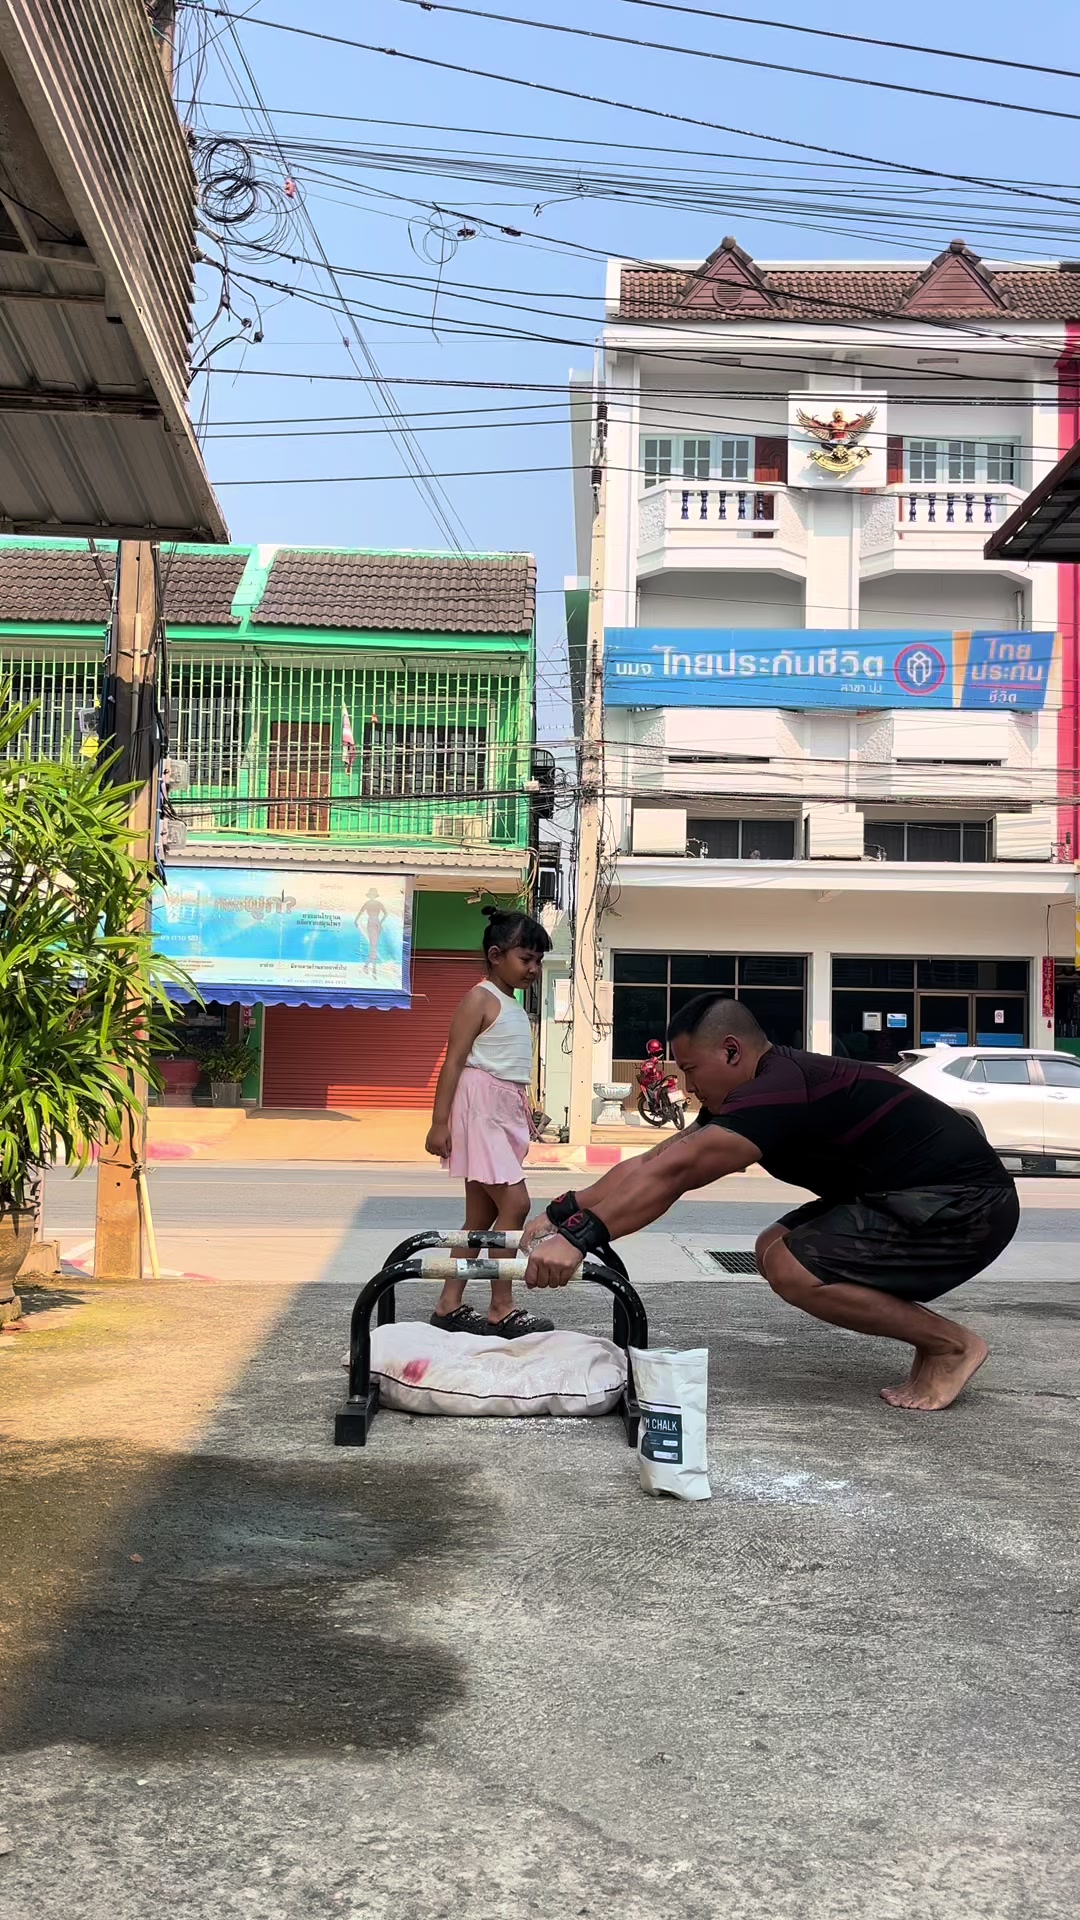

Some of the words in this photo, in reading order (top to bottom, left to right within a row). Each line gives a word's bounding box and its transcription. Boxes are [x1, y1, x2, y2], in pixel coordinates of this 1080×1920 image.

[984, 638, 1032, 660] ไทย
[652, 645, 883, 678] ไทยประกันชีวิต
[971, 661, 1043, 681] ประกัน
[989, 690, 1017, 704] ชีวิต
[651, 1419, 678, 1431] CHALK
